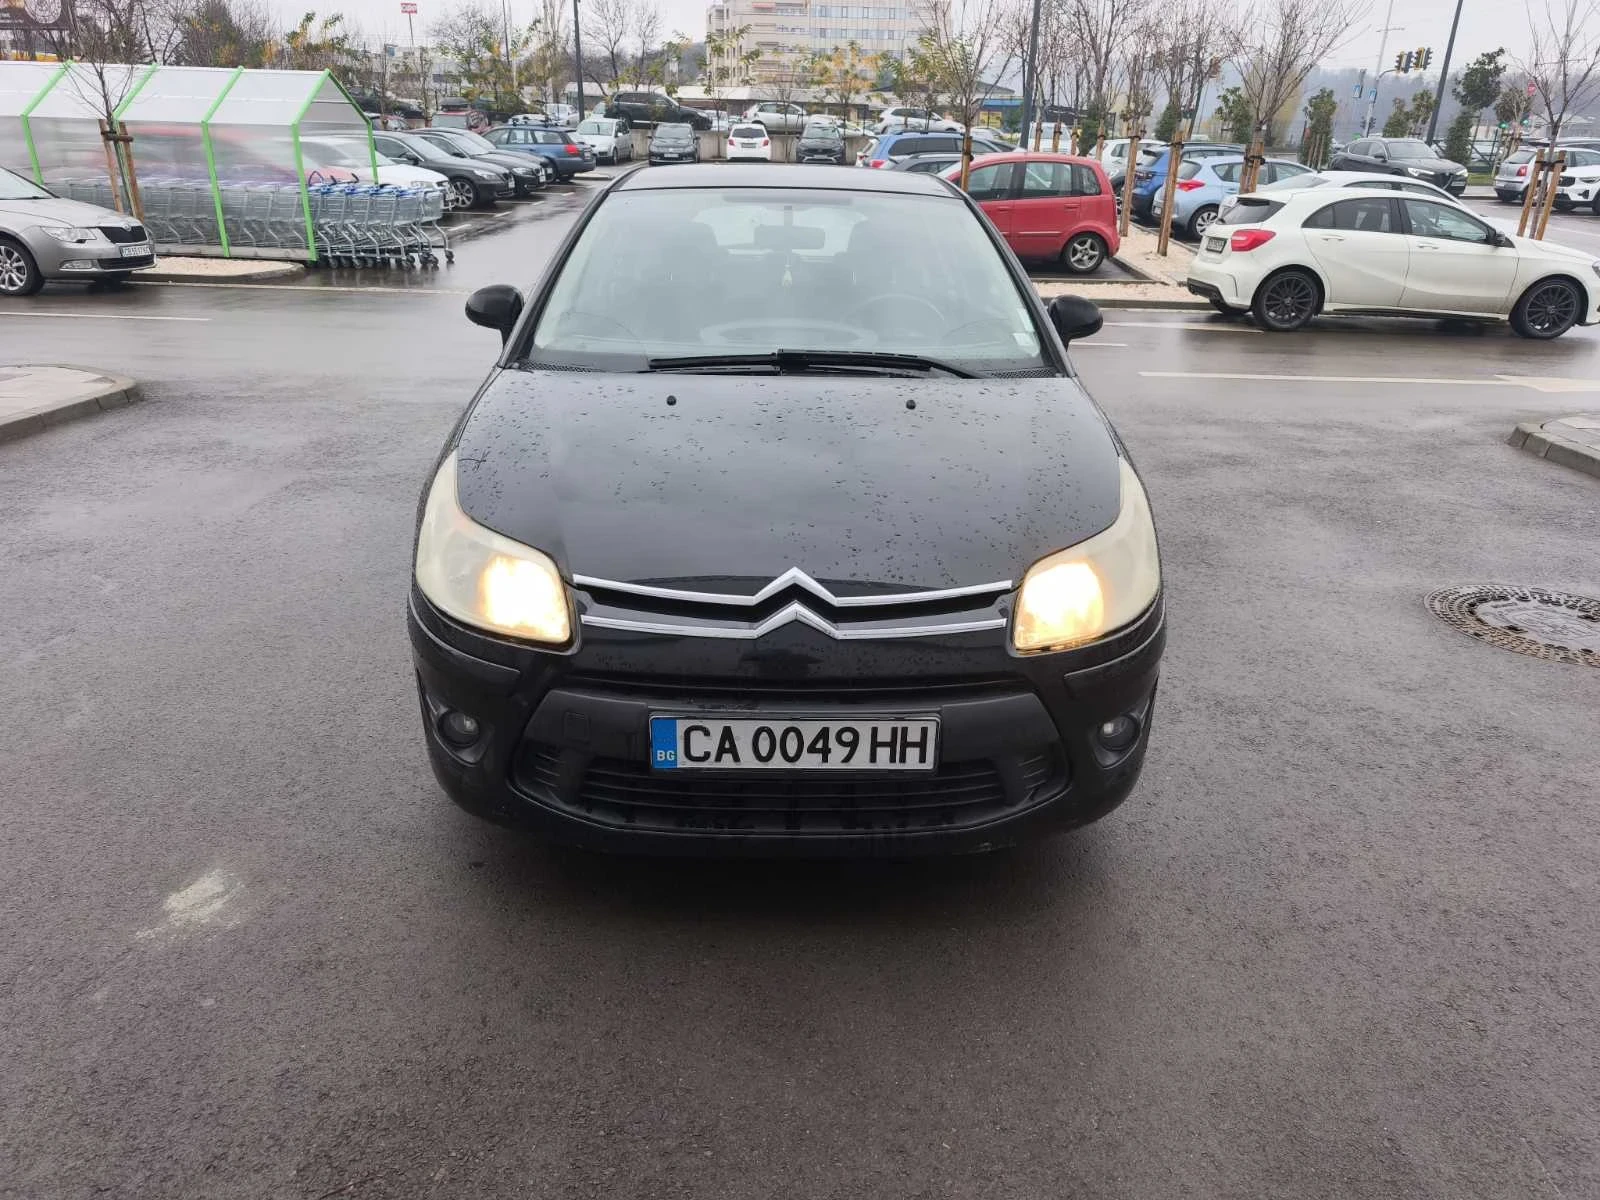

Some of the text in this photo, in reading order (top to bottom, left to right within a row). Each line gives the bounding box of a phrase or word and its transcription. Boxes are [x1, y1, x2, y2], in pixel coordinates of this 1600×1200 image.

[656, 750, 676, 761] BG
[683, 725, 929, 764] CA 0049 HH
